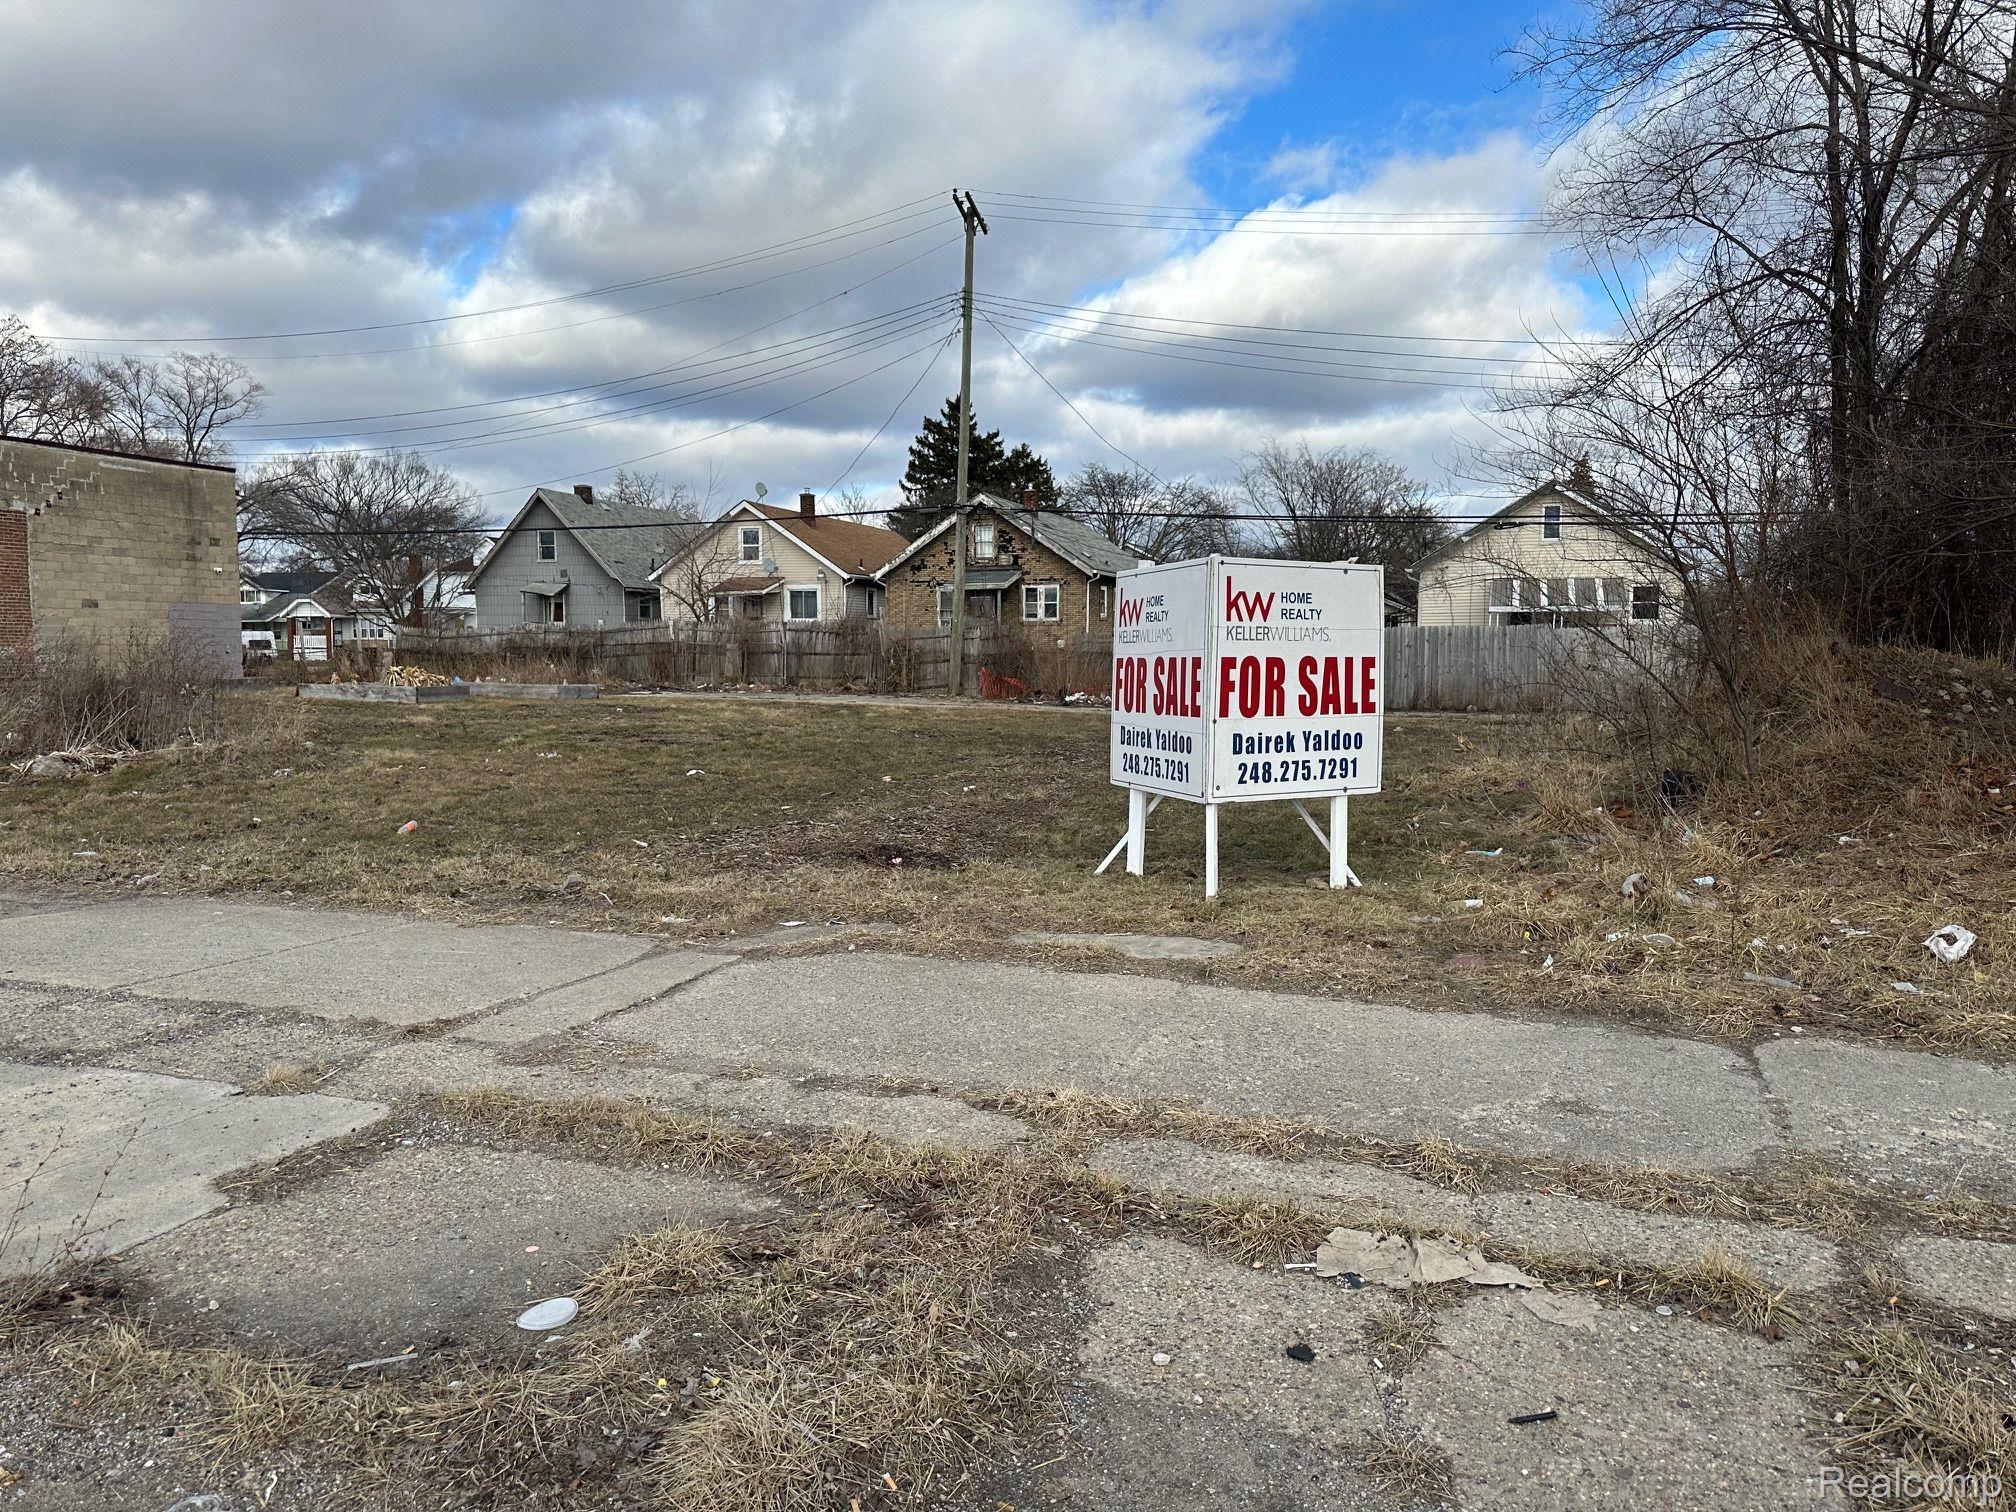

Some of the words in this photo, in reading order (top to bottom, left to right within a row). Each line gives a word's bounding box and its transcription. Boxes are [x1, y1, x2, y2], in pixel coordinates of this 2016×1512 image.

[1119, 588, 1144, 627] kw
[1146, 595, 1164, 608] HOME
[1226, 576, 1275, 623] kw
[1281, 592, 1312, 604] HOME
[1145, 610, 1169, 623] REALTY
[1281, 608, 1322, 620] REALTY
[1115, 656, 1147, 714] FOR
[1153, 655, 1201, 718] SALE
[1219, 655, 1286, 719] FOR
[1298, 655, 1376, 717] SALE
[1120, 726, 1152, 749] Dairek
[1155, 729, 1192, 755] Yaldoo
[1232, 732, 1296, 755] Dairek
[1302, 730, 1363, 752] Yaldoo
[1122, 753, 1189, 784] 248.275.7291
[1237, 757, 1358, 785] 248.275.7291
